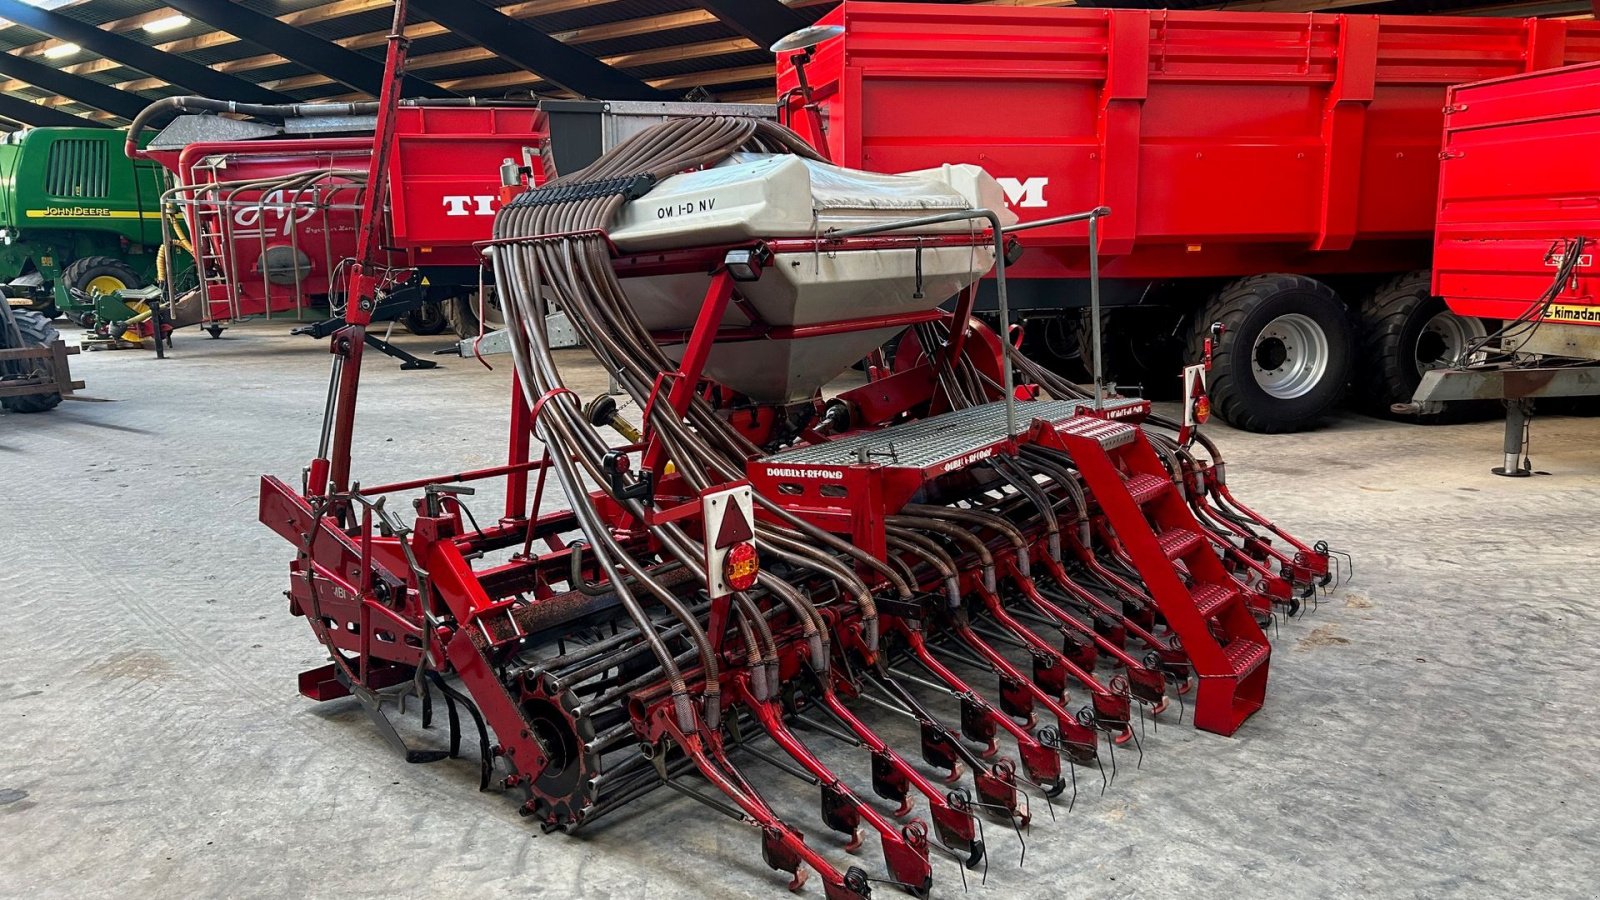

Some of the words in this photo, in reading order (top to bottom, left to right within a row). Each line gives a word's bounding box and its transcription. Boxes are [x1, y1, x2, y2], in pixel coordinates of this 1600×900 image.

[43, 206, 73, 216] JOHN
[73, 206, 111, 216] DEERE
[442, 195, 502, 216] TI
